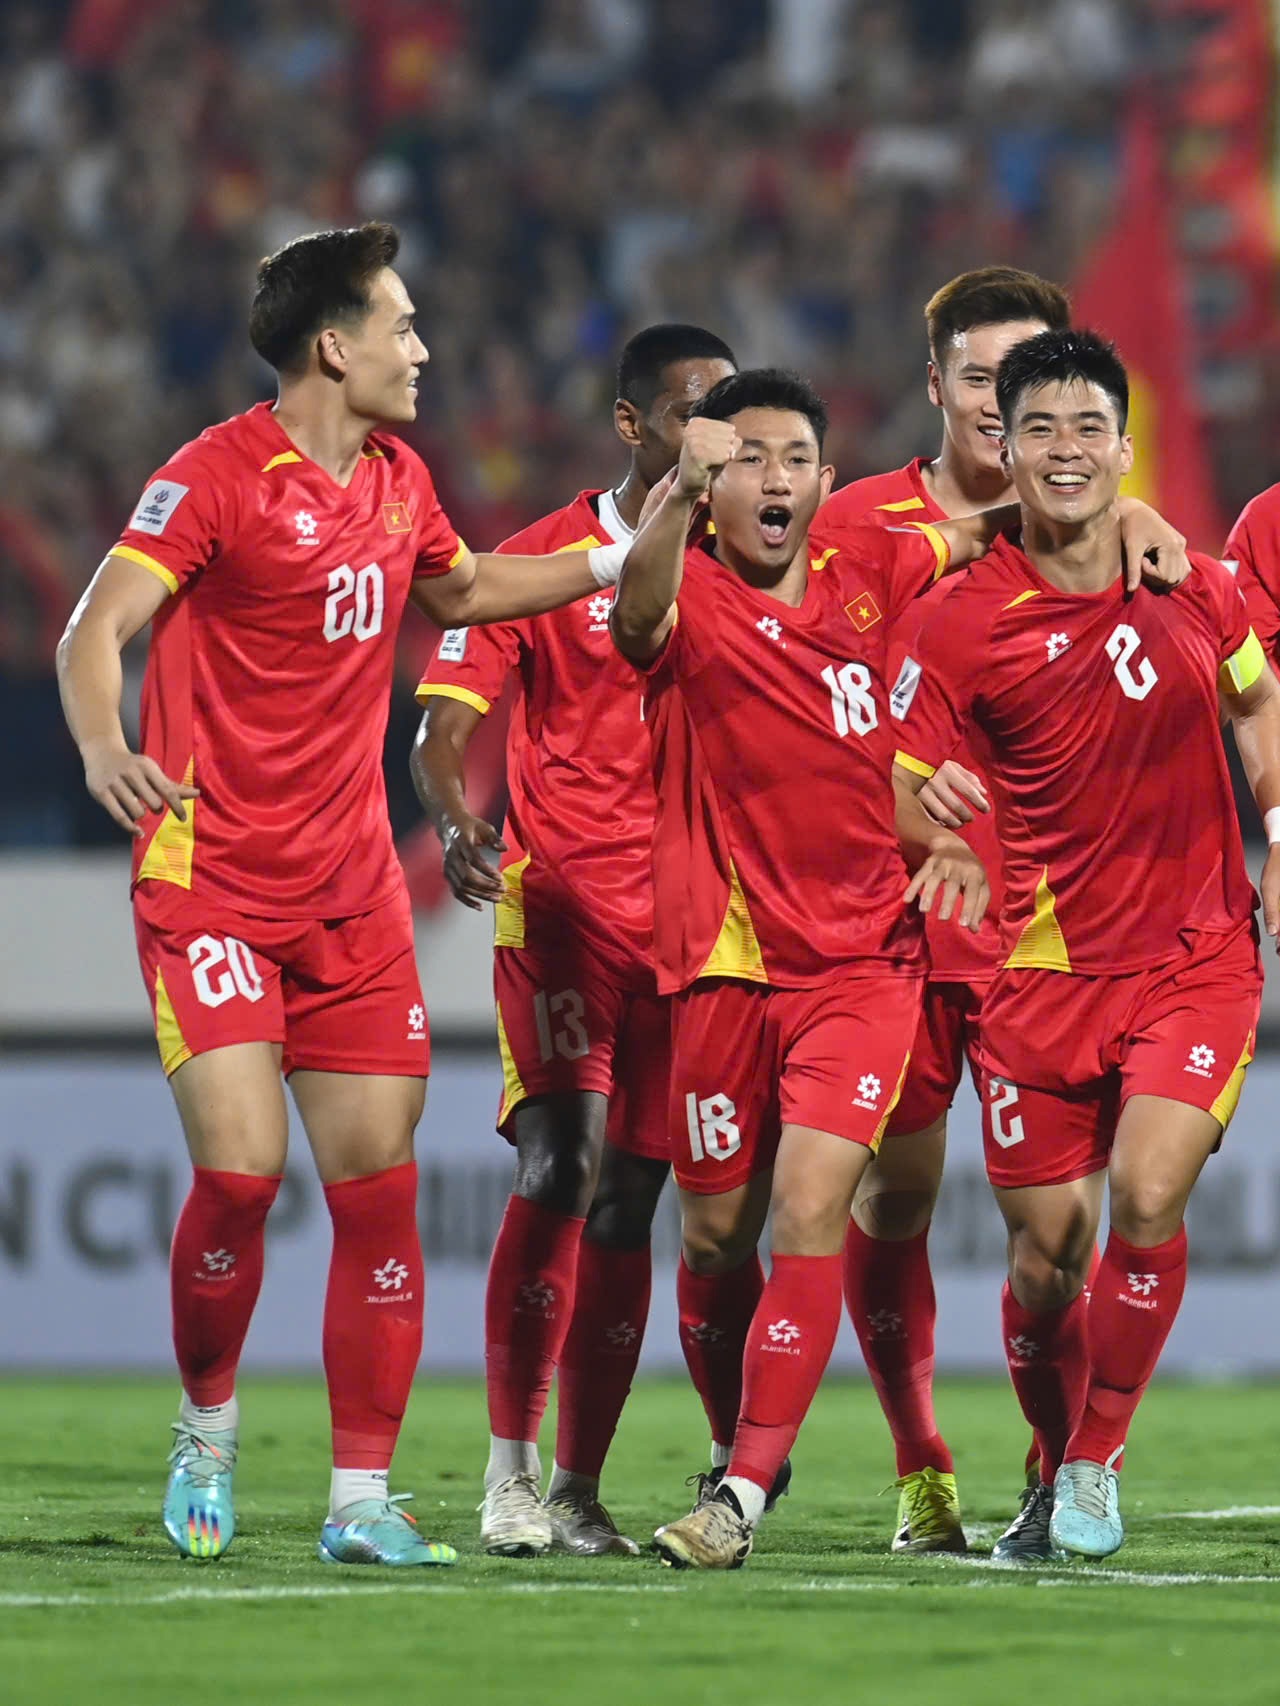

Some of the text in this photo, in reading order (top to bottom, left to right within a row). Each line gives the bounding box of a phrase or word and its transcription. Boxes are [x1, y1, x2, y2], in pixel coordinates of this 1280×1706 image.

[322, 563, 385, 643] 20
[820, 662, 879, 738] 18
[1104, 623, 1159, 701] 2
[187, 934, 265, 1008] 20
[534, 988, 590, 1065] 13
[686, 1092, 741, 1163] 18
[989, 1076, 1025, 1149] 2
[62, 1154, 312, 1275] CP
